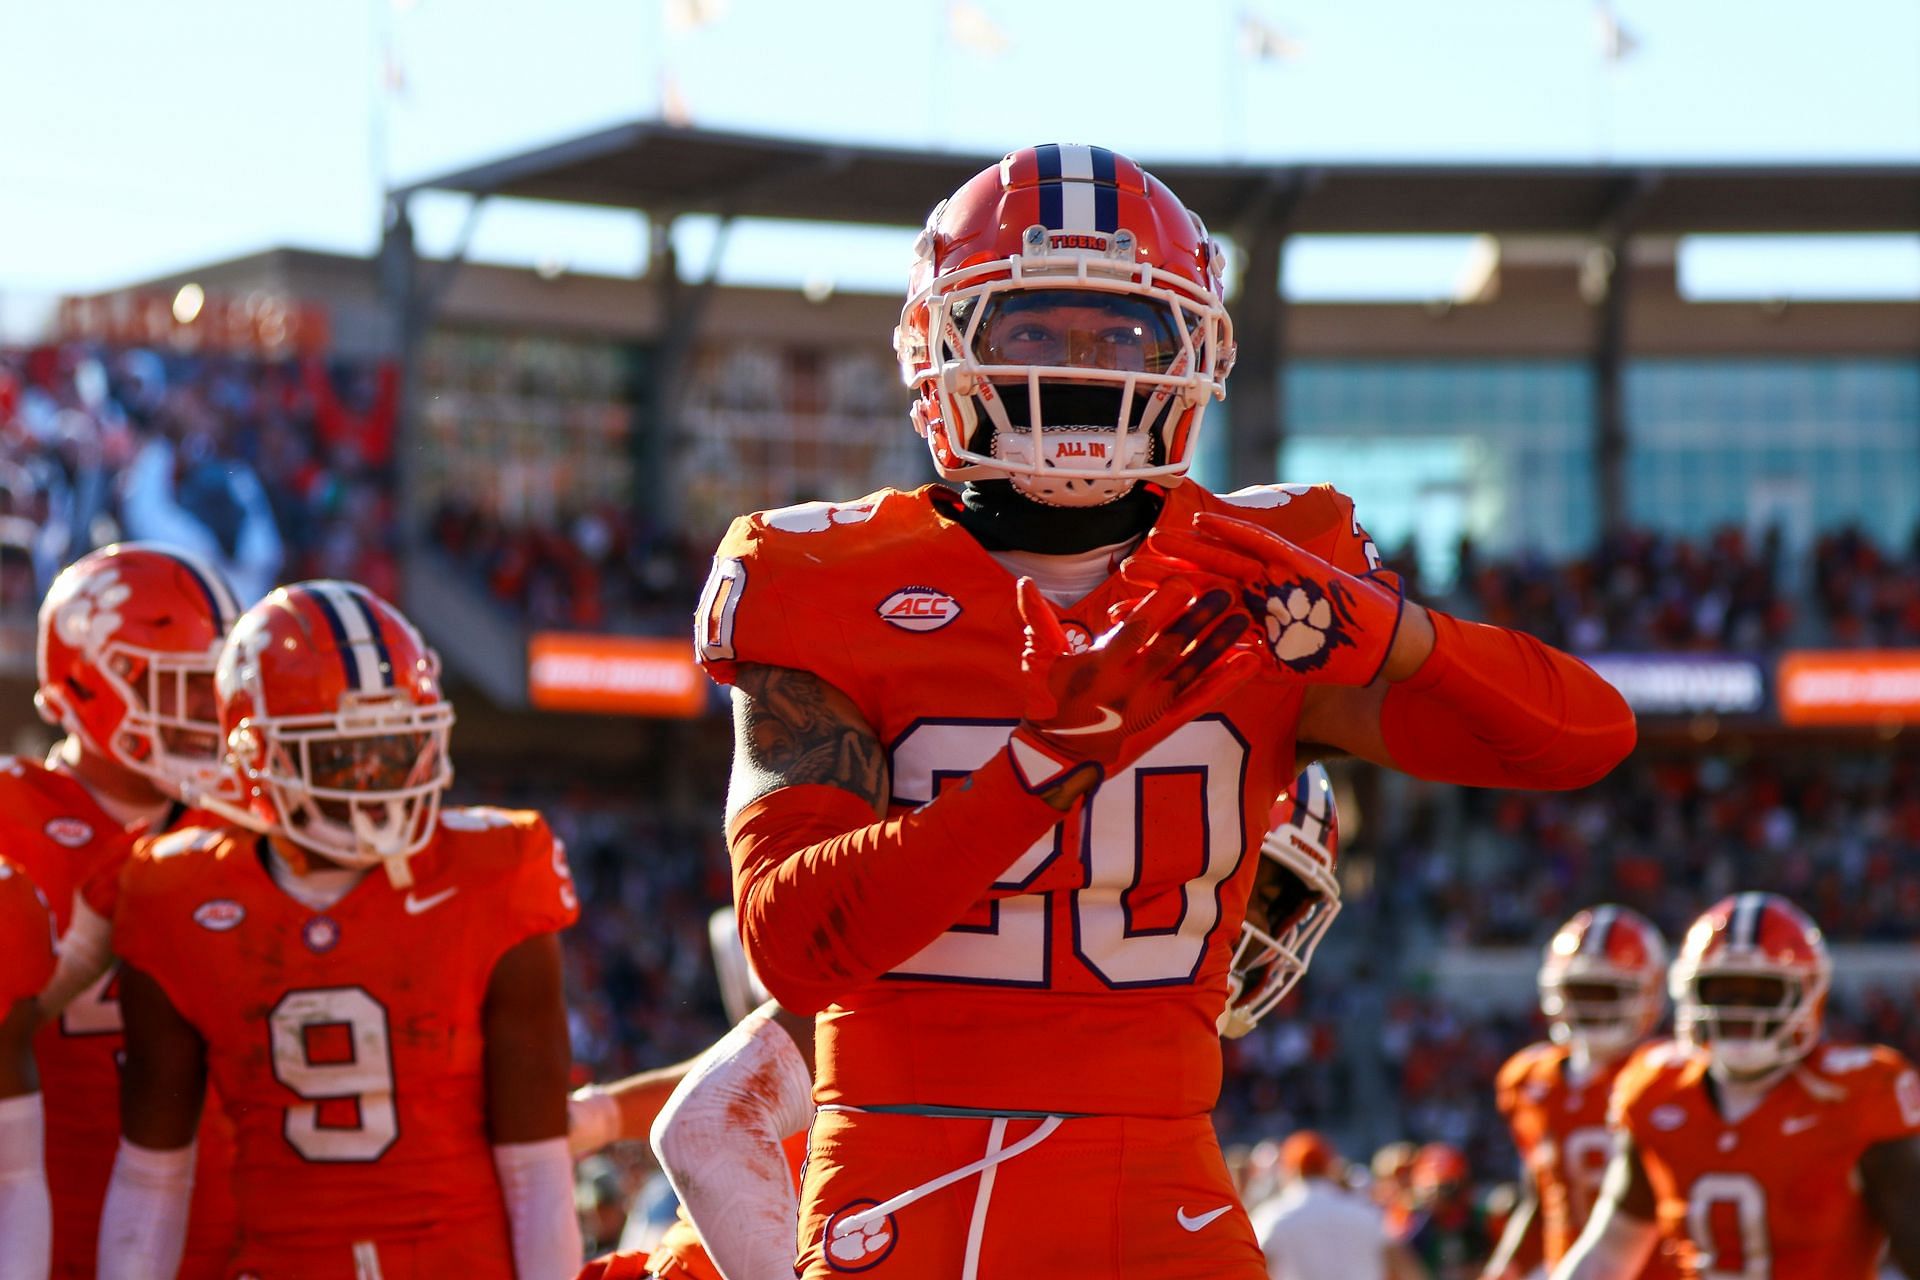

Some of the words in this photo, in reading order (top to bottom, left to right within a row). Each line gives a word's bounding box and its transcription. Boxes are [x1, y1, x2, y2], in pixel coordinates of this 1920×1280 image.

[1049, 234, 1107, 251] TIGERS
[1056, 441, 1086, 458] ALL
[1088, 442, 1106, 458] IN
[887, 597, 953, 616] ACC
[877, 712, 1251, 990] 20
[268, 984, 402, 1164] 9
